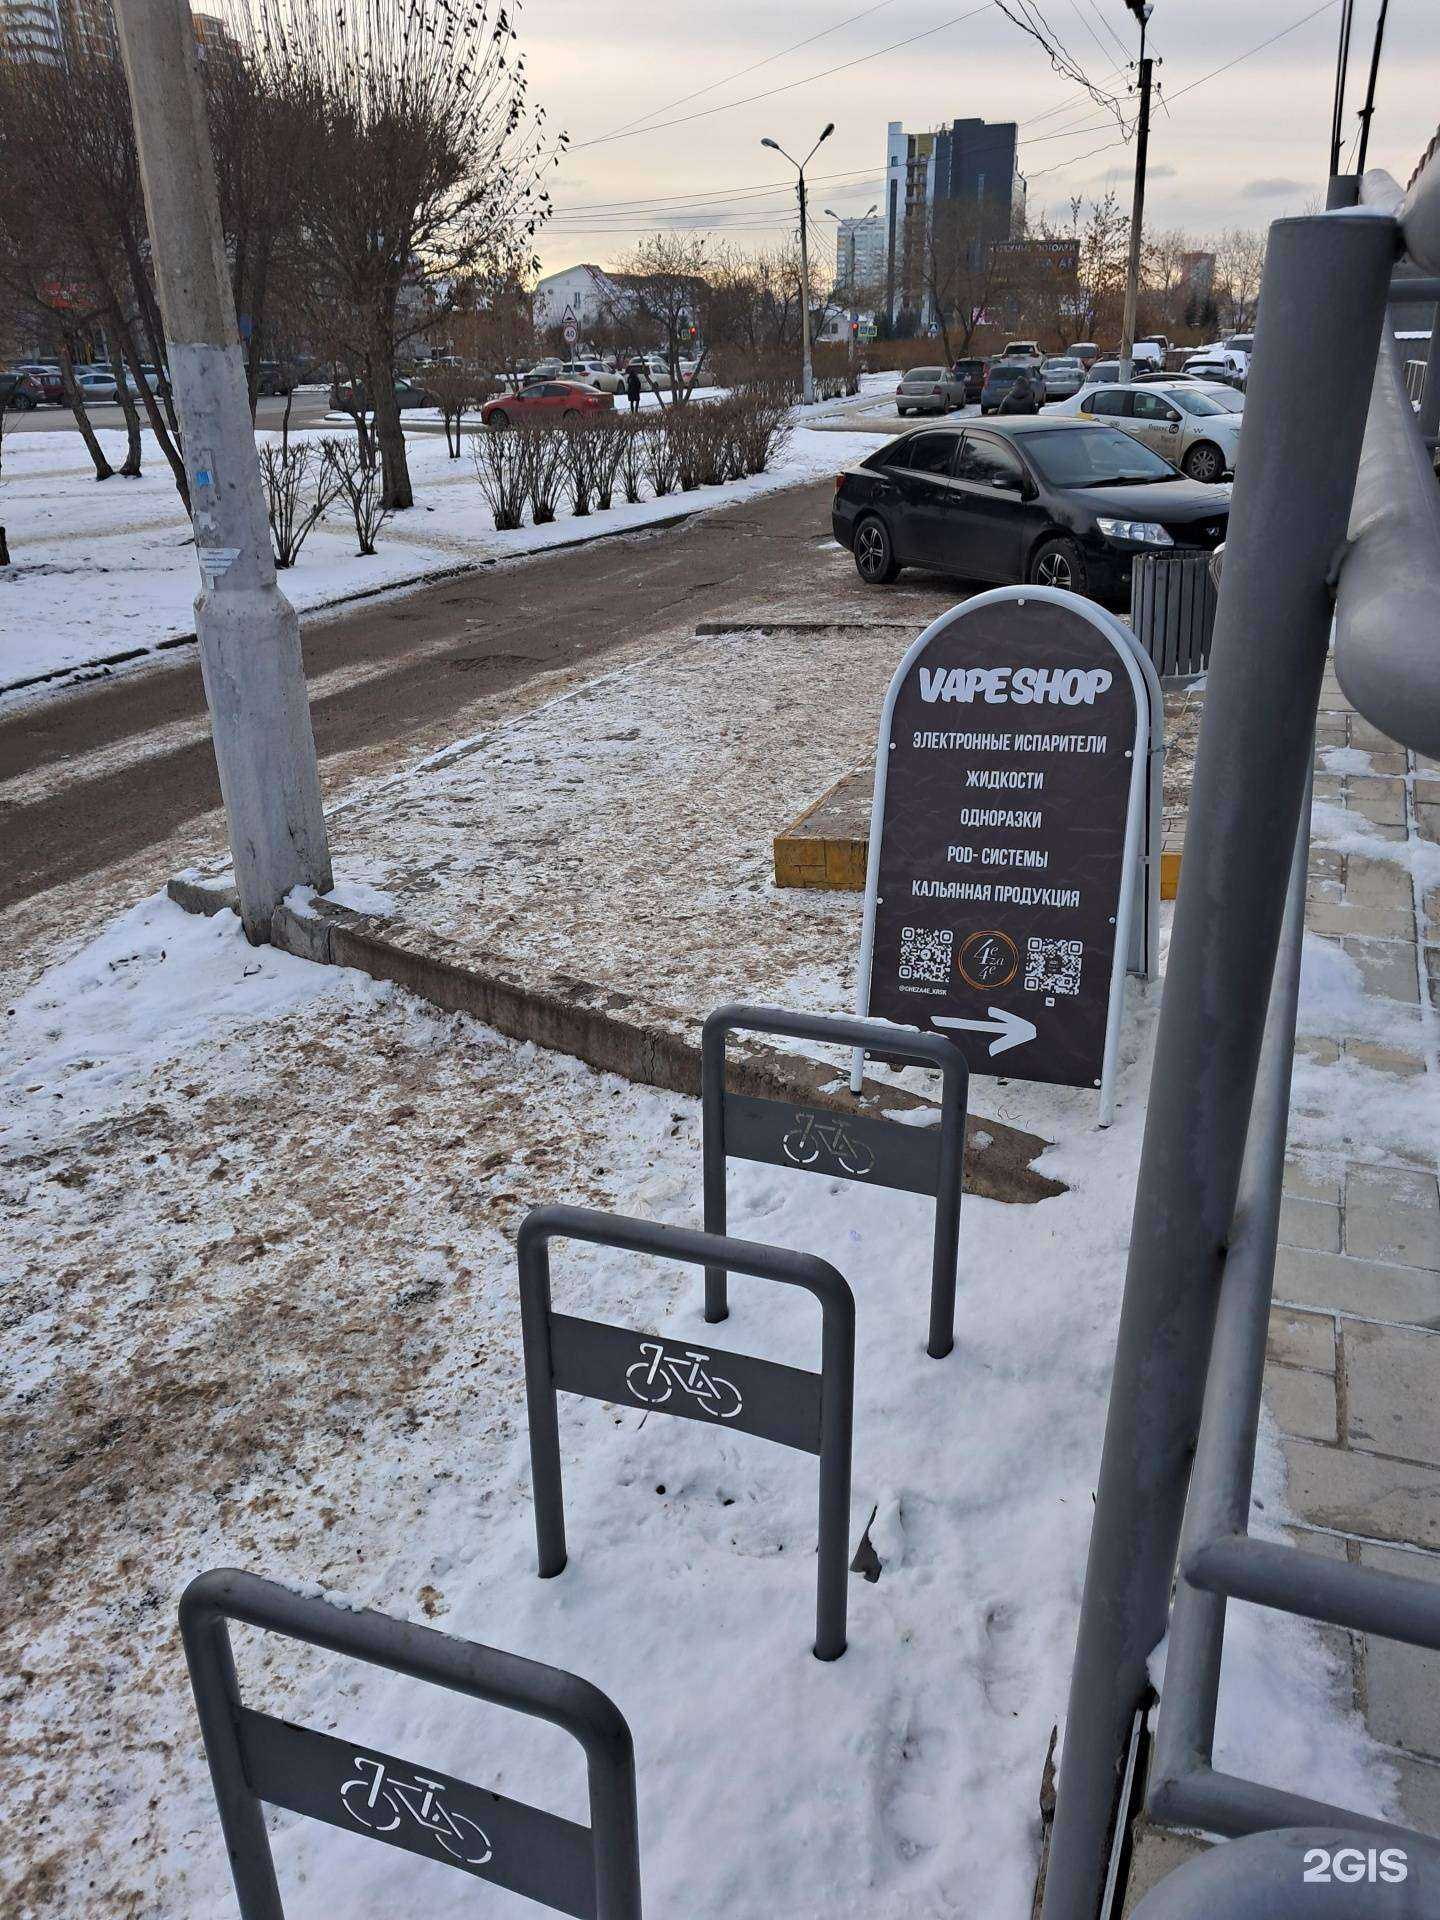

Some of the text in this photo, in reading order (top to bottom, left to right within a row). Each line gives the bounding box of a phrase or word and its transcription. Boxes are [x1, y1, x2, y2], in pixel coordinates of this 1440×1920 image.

[919, 667, 1113, 705] VAPE SHOP
[913, 731, 1107, 754] ЭЛЕКТРОННЫЕ ИСПАРИТЕЛИ
[965, 769, 1044, 790] ЖИДКОСТИ
[960, 808, 1042, 829] ОДНОРАЗКИ
[981, 848, 1049, 868] СИСТЕМЫ
[911, 879, 1080, 907] КАЛЬЯННАЯ ПРОДУКЦИЯ
